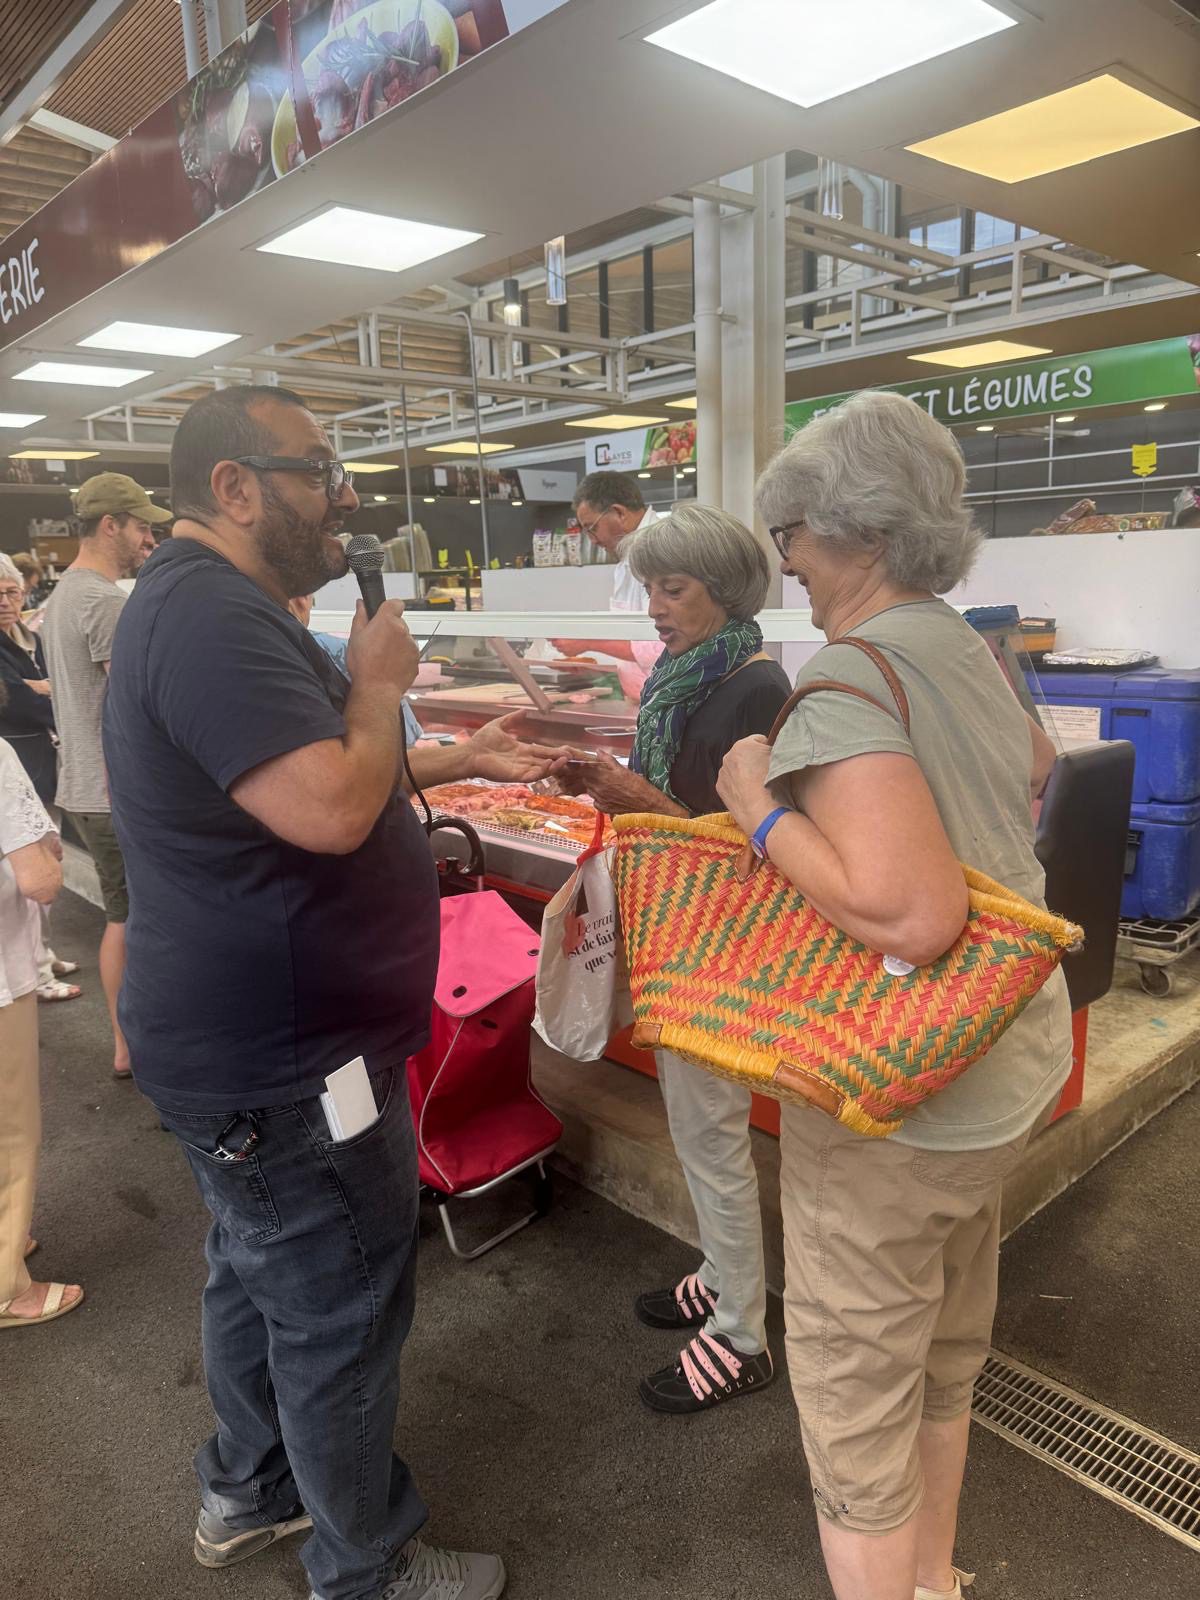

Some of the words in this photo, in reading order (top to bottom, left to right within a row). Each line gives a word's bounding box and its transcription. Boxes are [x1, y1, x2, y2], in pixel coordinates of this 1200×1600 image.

[0, 237, 45, 324] ERIE
[906, 389, 941, 417] T
[947, 365, 1093, 417] LÉGUMES
[592, 909, 614, 930] vrai
[581, 938, 596, 953] de
[584, 953, 607, 973] que
[714, 1375, 754, 1400] LULU
